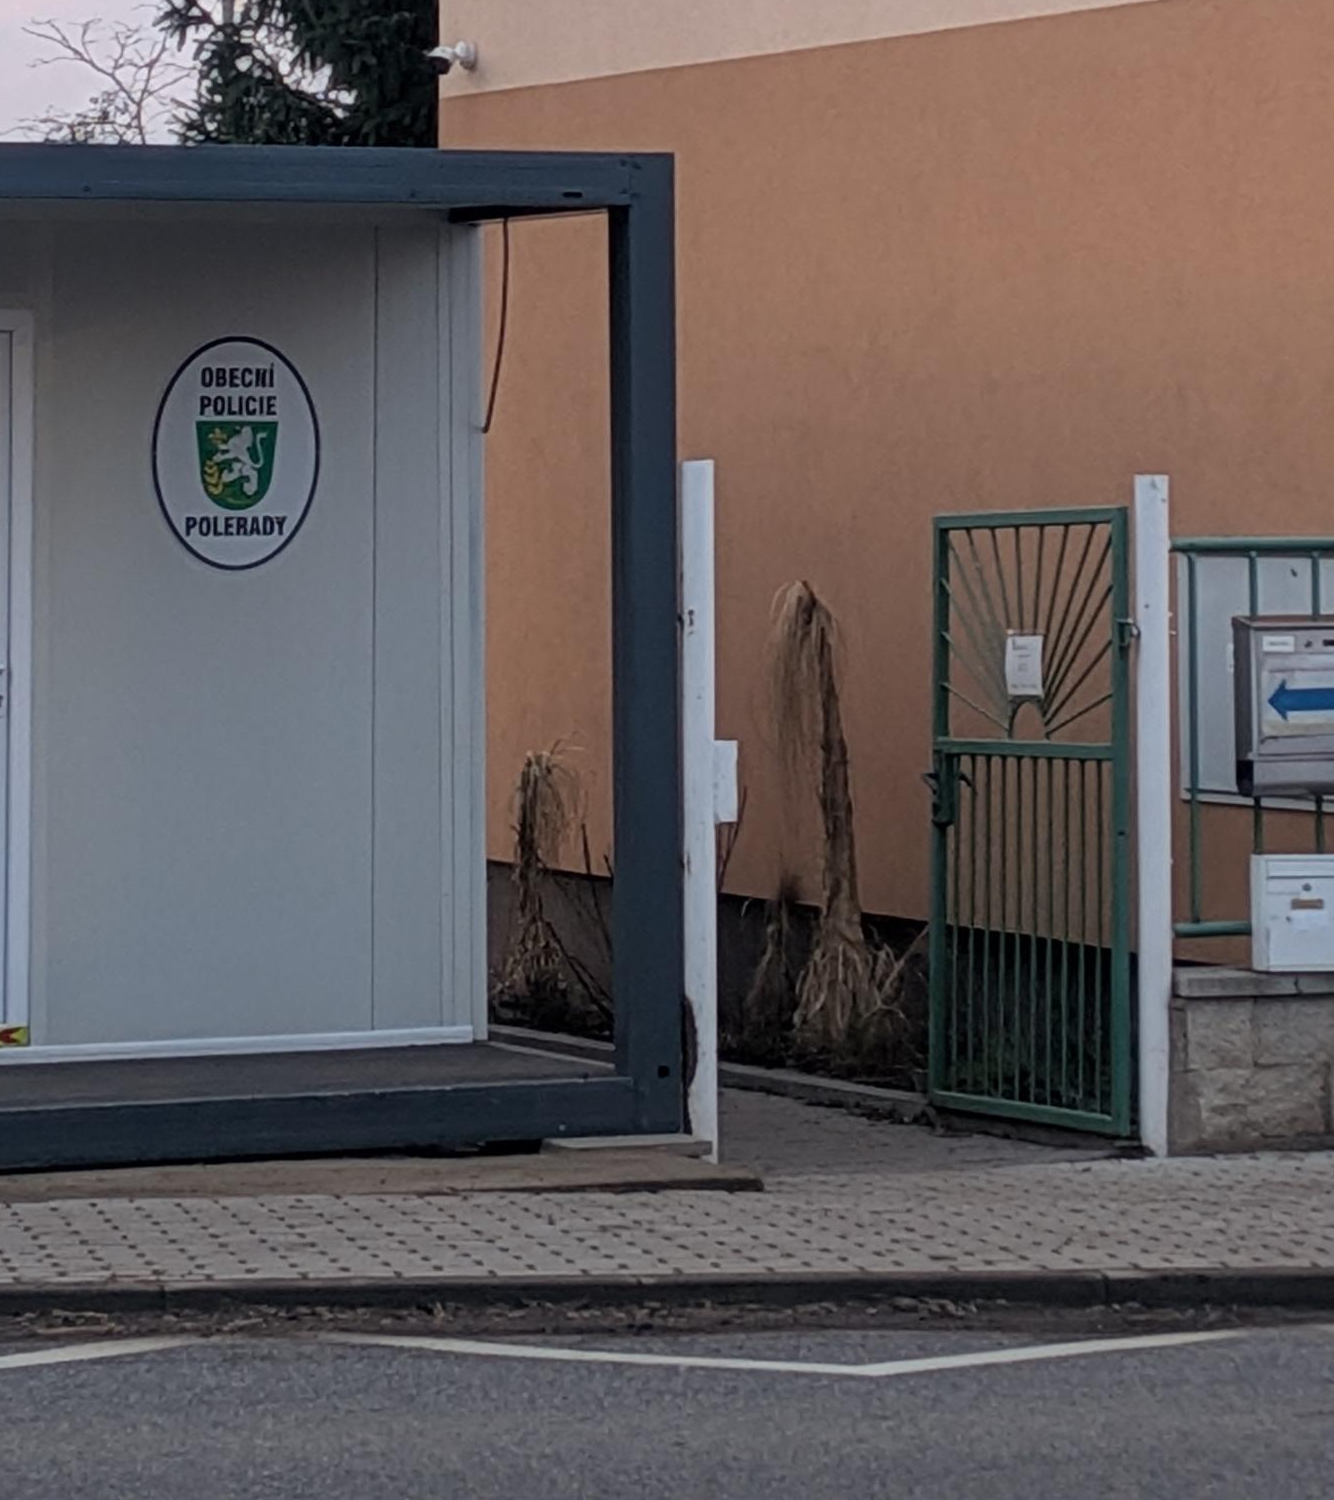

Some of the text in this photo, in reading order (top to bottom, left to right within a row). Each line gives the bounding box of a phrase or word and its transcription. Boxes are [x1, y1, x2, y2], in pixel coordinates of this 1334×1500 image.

[201, 362, 275, 388] OBECNÍ
[199, 395, 277, 416] POLICIE
[185, 515, 287, 537] POLERADY
